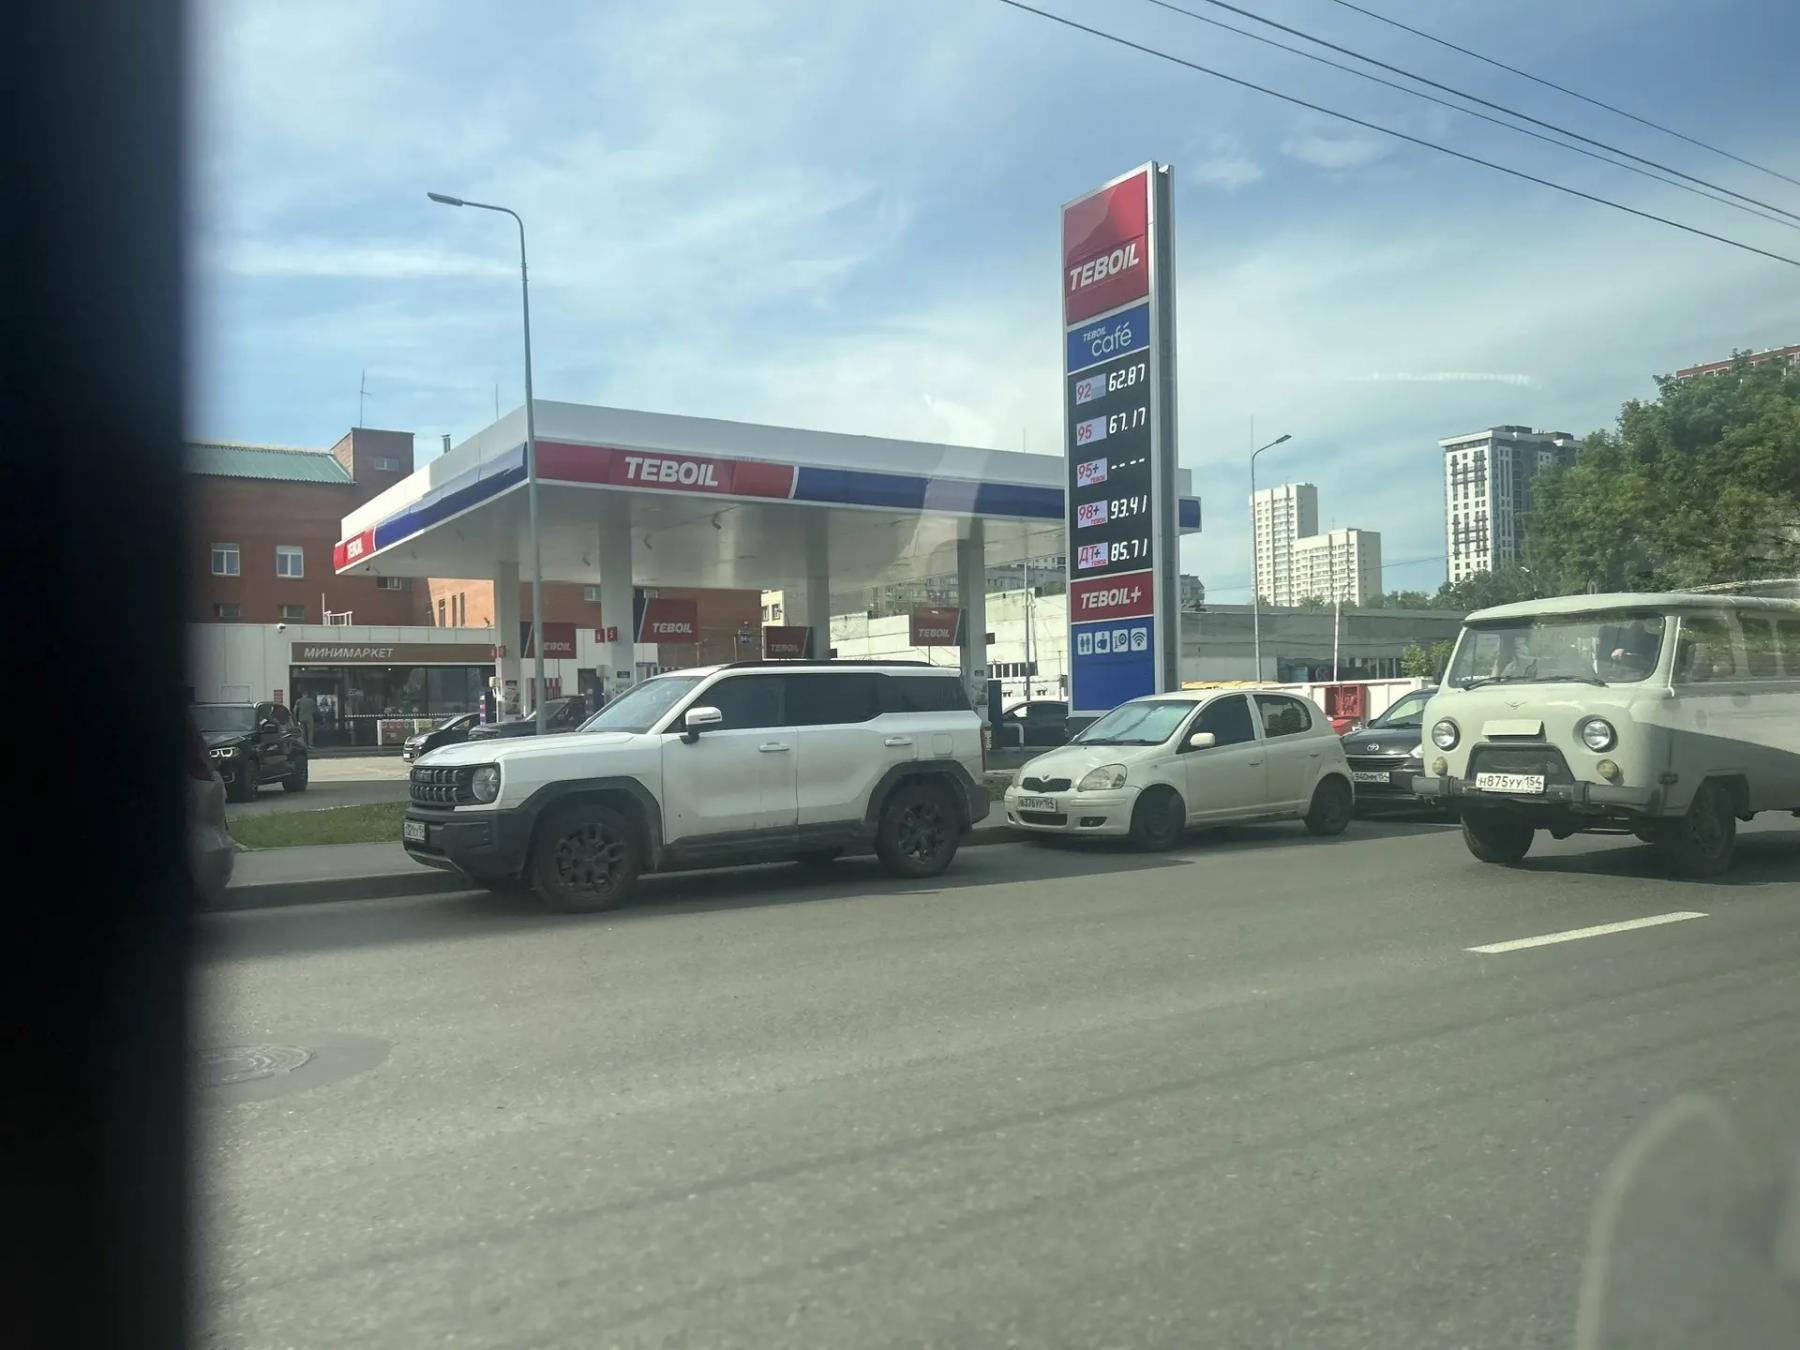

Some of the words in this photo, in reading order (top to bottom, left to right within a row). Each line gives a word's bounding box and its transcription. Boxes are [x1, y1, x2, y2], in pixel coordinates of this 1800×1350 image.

[1070, 243, 1140, 291] TEBOIL
[1083, 327, 1107, 342] TEBOIL
[1091, 321, 1132, 357] café
[1077, 382, 1092, 401] 92
[1108, 363, 1145, 392] 62.87
[1077, 424, 1092, 441] 95
[1109, 407, 1146, 434] 67.17
[625, 456, 718, 487] TEBOIL
[1078, 462, 1099, 480] 95+
[1079, 504, 1100, 520] 98+
[1110, 495, 1147, 519] 93.41
[1079, 545, 1101, 565] ДТ+
[1110, 538, 1148, 561] 85.71
[1080, 586, 1142, 609] TEBOIL+
[652, 622, 693, 633] TEBOIL
[918, 628, 950, 638] TEBOIL
[303, 647, 395, 659] МИНИМАРКЕТ
[543, 641, 571, 651] EBOIL
[1479, 775, 1522, 788] Н875УУ
[1525, 776, 1542, 786] 154
